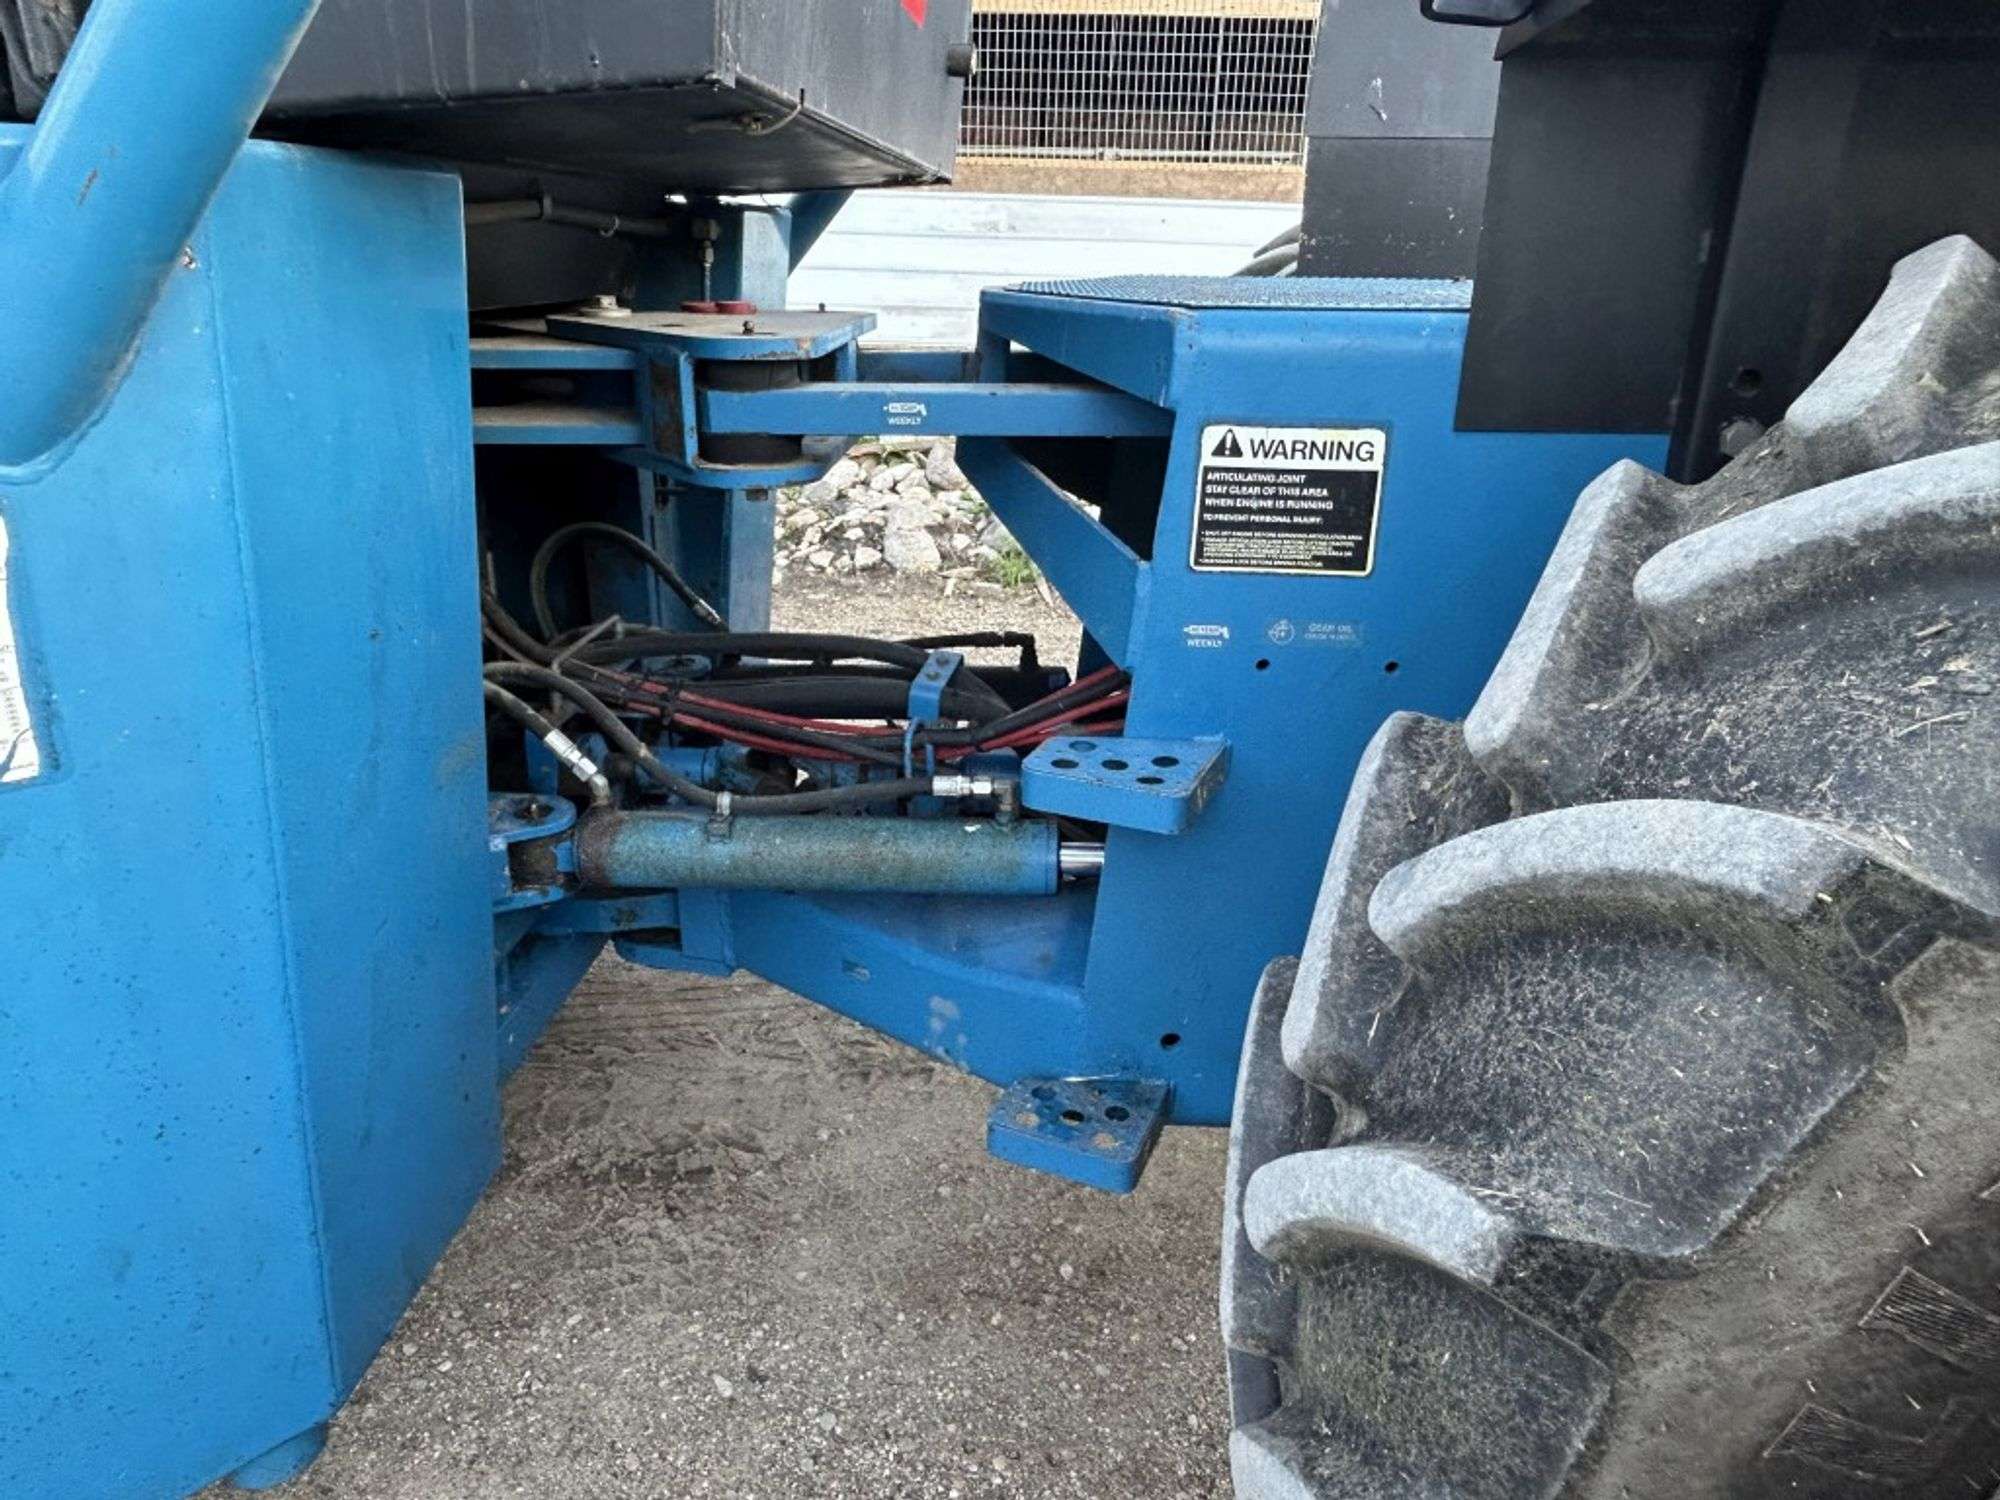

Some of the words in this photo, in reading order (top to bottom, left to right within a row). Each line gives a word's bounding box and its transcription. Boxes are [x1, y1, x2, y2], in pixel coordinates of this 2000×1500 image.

[888, 417, 921, 426] WEEKLY
[1250, 439, 1375, 462] WARNING
[1207, 472, 1276, 483] ARTICULATING
[1277, 474, 1307, 484] JOINT
[1205, 484, 1227, 494] STAY
[1228, 486, 1261, 495] CLEAR
[1262, 486, 1276, 496] OF
[1278, 487, 1300, 496] THIS
[1301, 487, 1329, 497] AREA
[1205, 498, 1234, 507] WHEN
[1236, 498, 1274, 508] ENGINE
[1275, 500, 1285, 509] IS
[1286, 500, 1334, 510] RUNNING
[1203, 513, 1214, 521] TO
[1250, 515, 1292, 523] PERSONAL
[1186, 639, 1223, 648] WEEKLY
